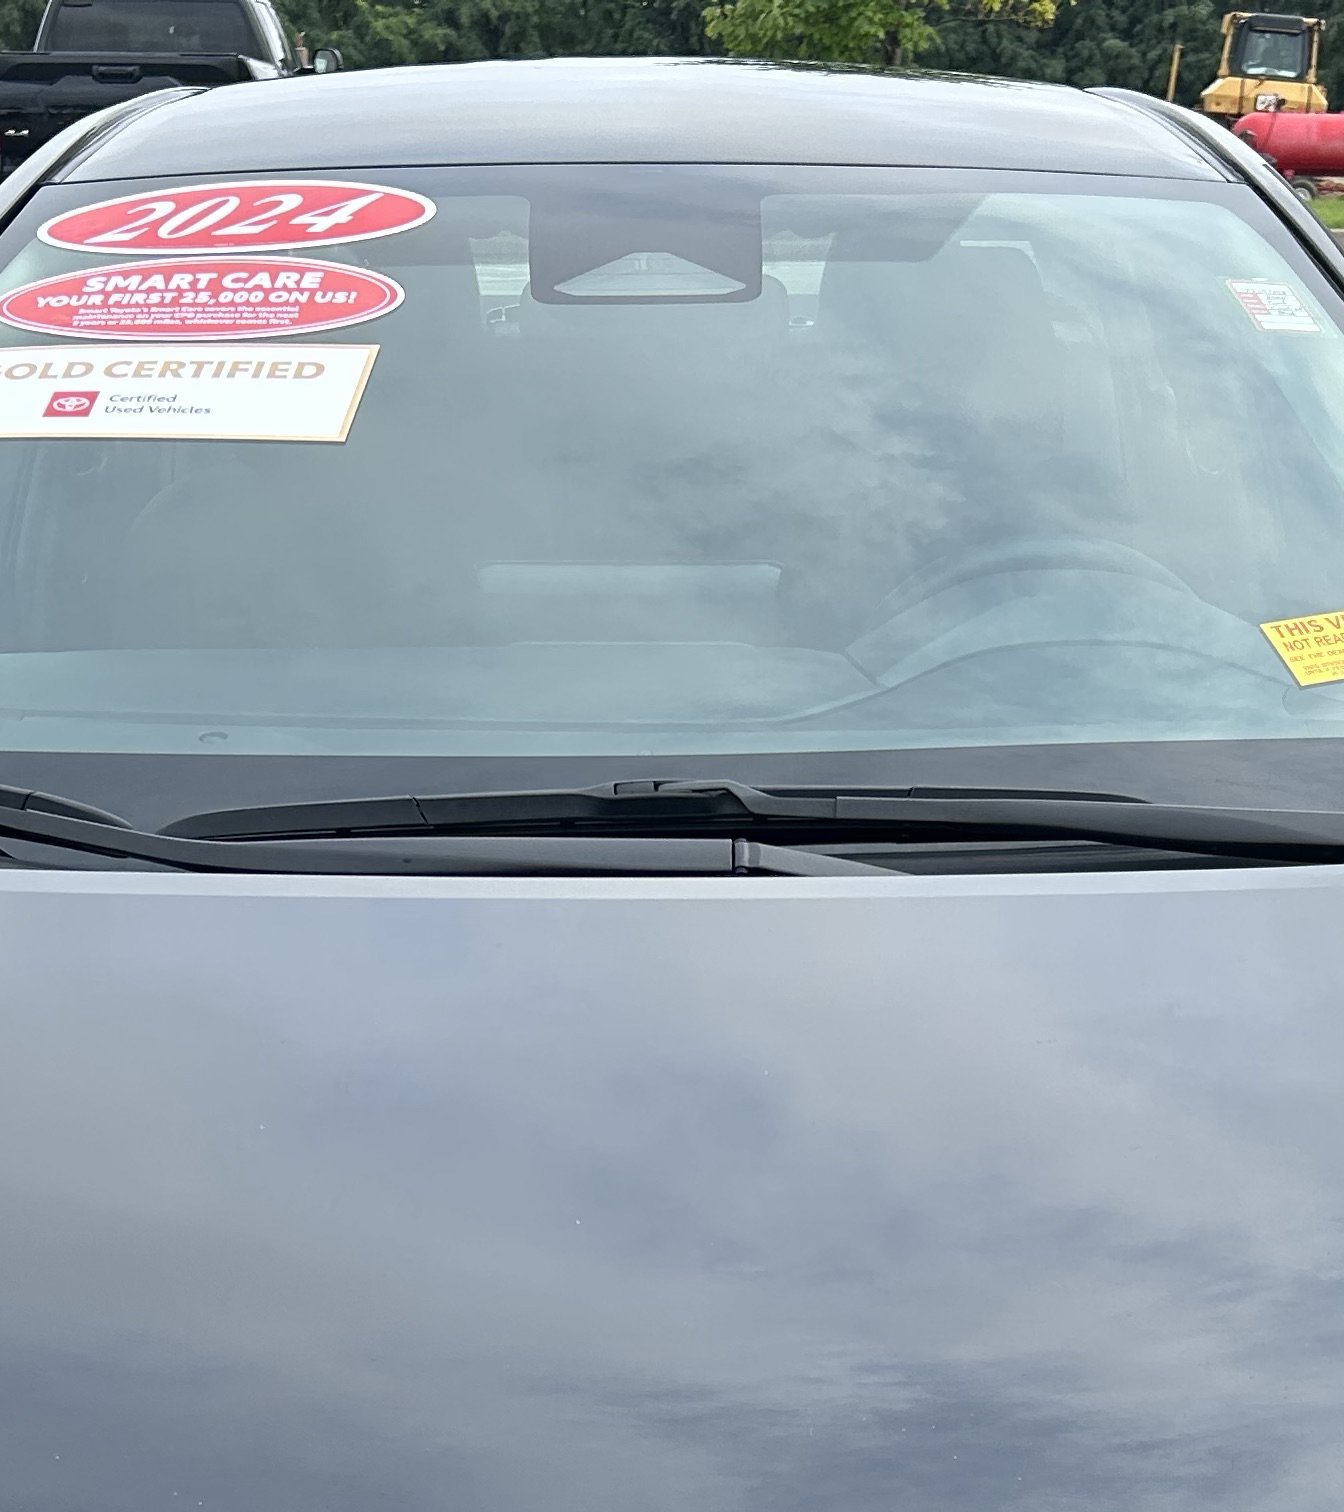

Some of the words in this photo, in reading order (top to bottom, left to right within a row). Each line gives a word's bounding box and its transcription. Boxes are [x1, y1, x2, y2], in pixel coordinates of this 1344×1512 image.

[83, 192, 385, 244] 2024
[81, 272, 219, 293] SMART
[221, 271, 325, 289] CARE
[36, 294, 105, 308] YOUR
[107, 292, 179, 305] FIRST
[178, 291, 265, 305] 25,000
[268, 291, 311, 303] ON
[314, 291, 358, 304] US!
[103, 360, 325, 380] CERTIFIED
[109, 394, 178, 403] Certified
[105, 405, 144, 414] Used
[148, 405, 212, 415] Vehicles
[1270, 619, 1325, 639] THIS
[1282, 638, 1312, 652] NOT
